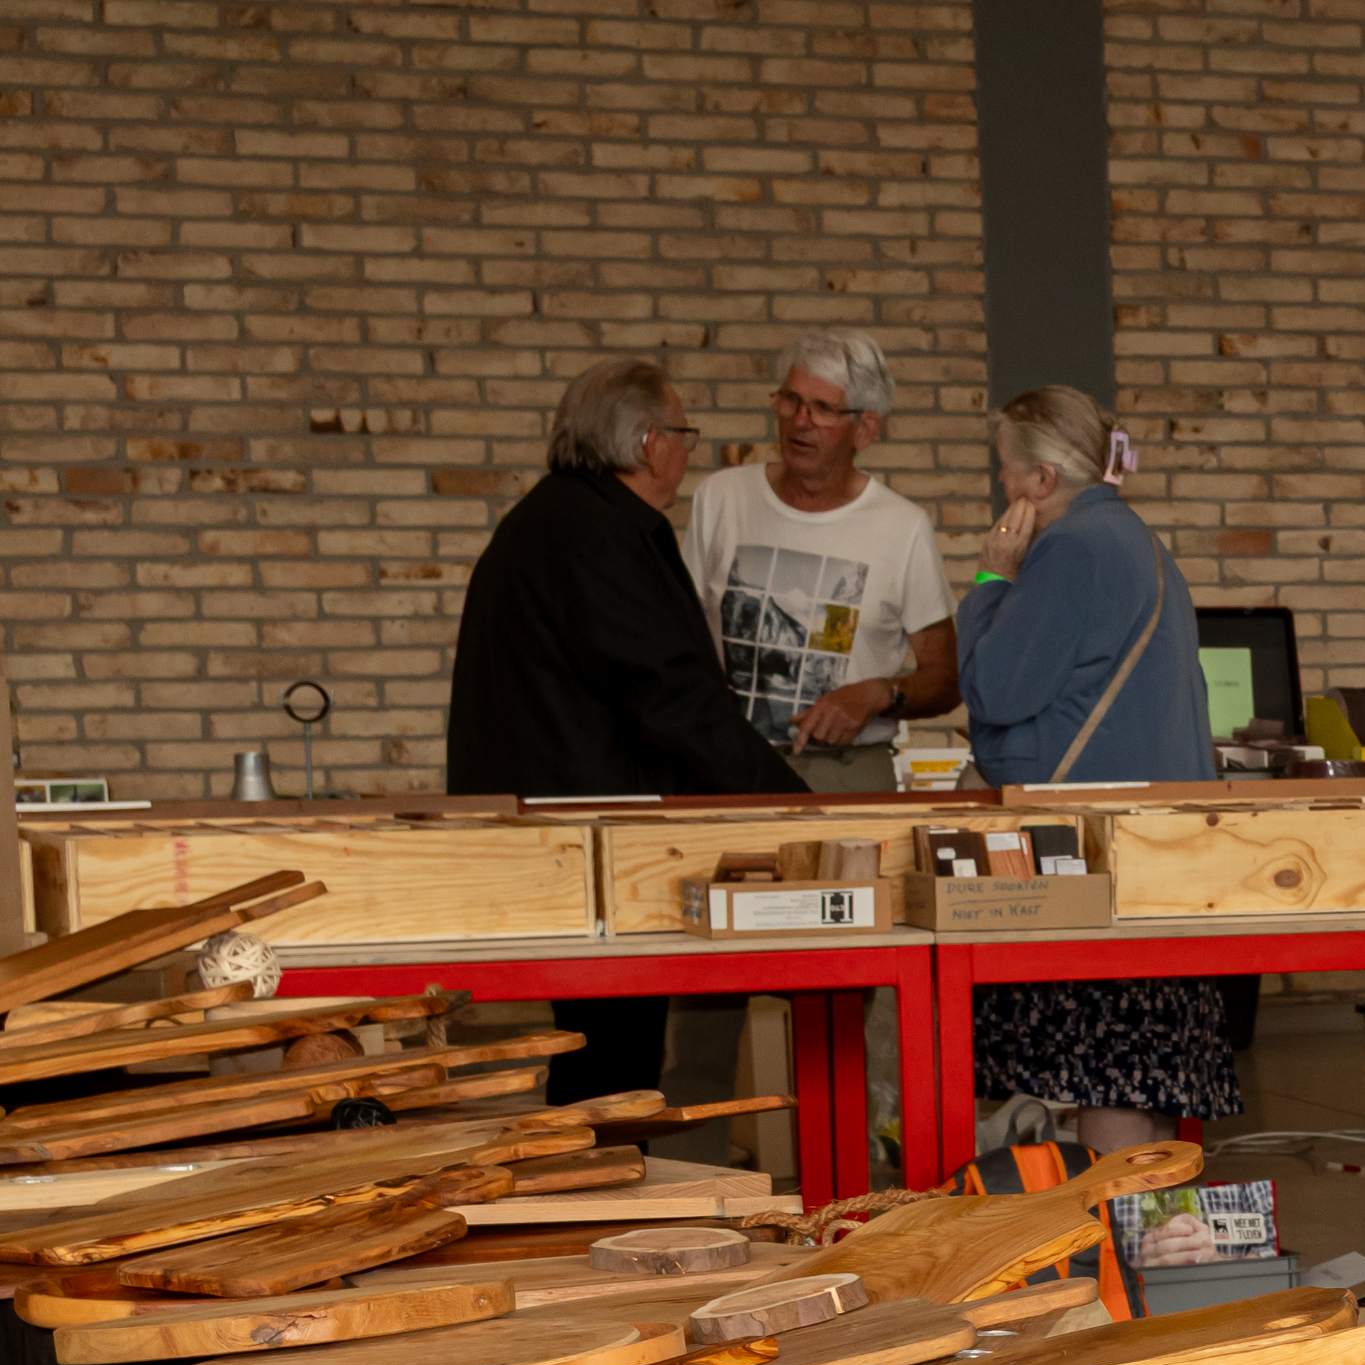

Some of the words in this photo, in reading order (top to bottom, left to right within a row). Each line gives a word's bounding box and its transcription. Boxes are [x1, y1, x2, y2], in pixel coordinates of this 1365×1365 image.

[952, 909, 982, 920] NIET
[991, 907, 1003, 918] IN
[1234, 1219, 1249, 1228] MEE
